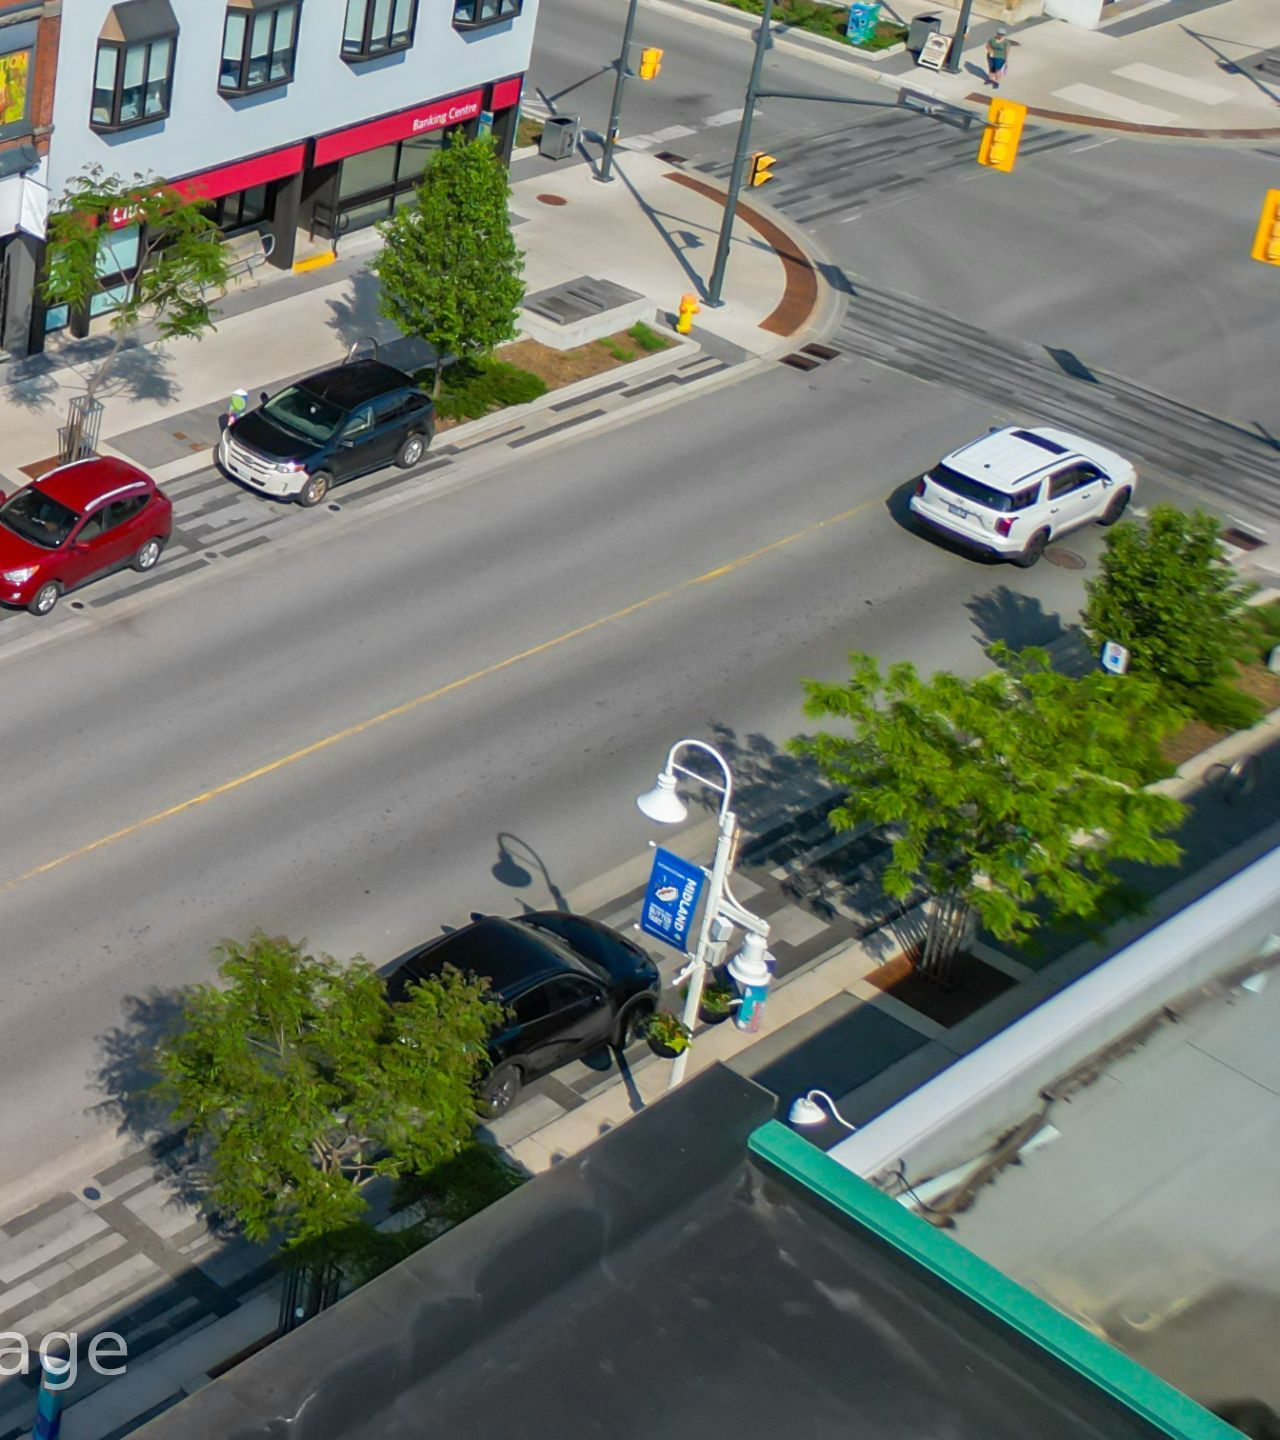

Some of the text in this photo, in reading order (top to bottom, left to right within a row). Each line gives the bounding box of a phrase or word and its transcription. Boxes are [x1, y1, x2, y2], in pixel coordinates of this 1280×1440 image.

[412, 103, 477, 131] Banking Centre
[674, 877, 697, 932] MIDLAND
